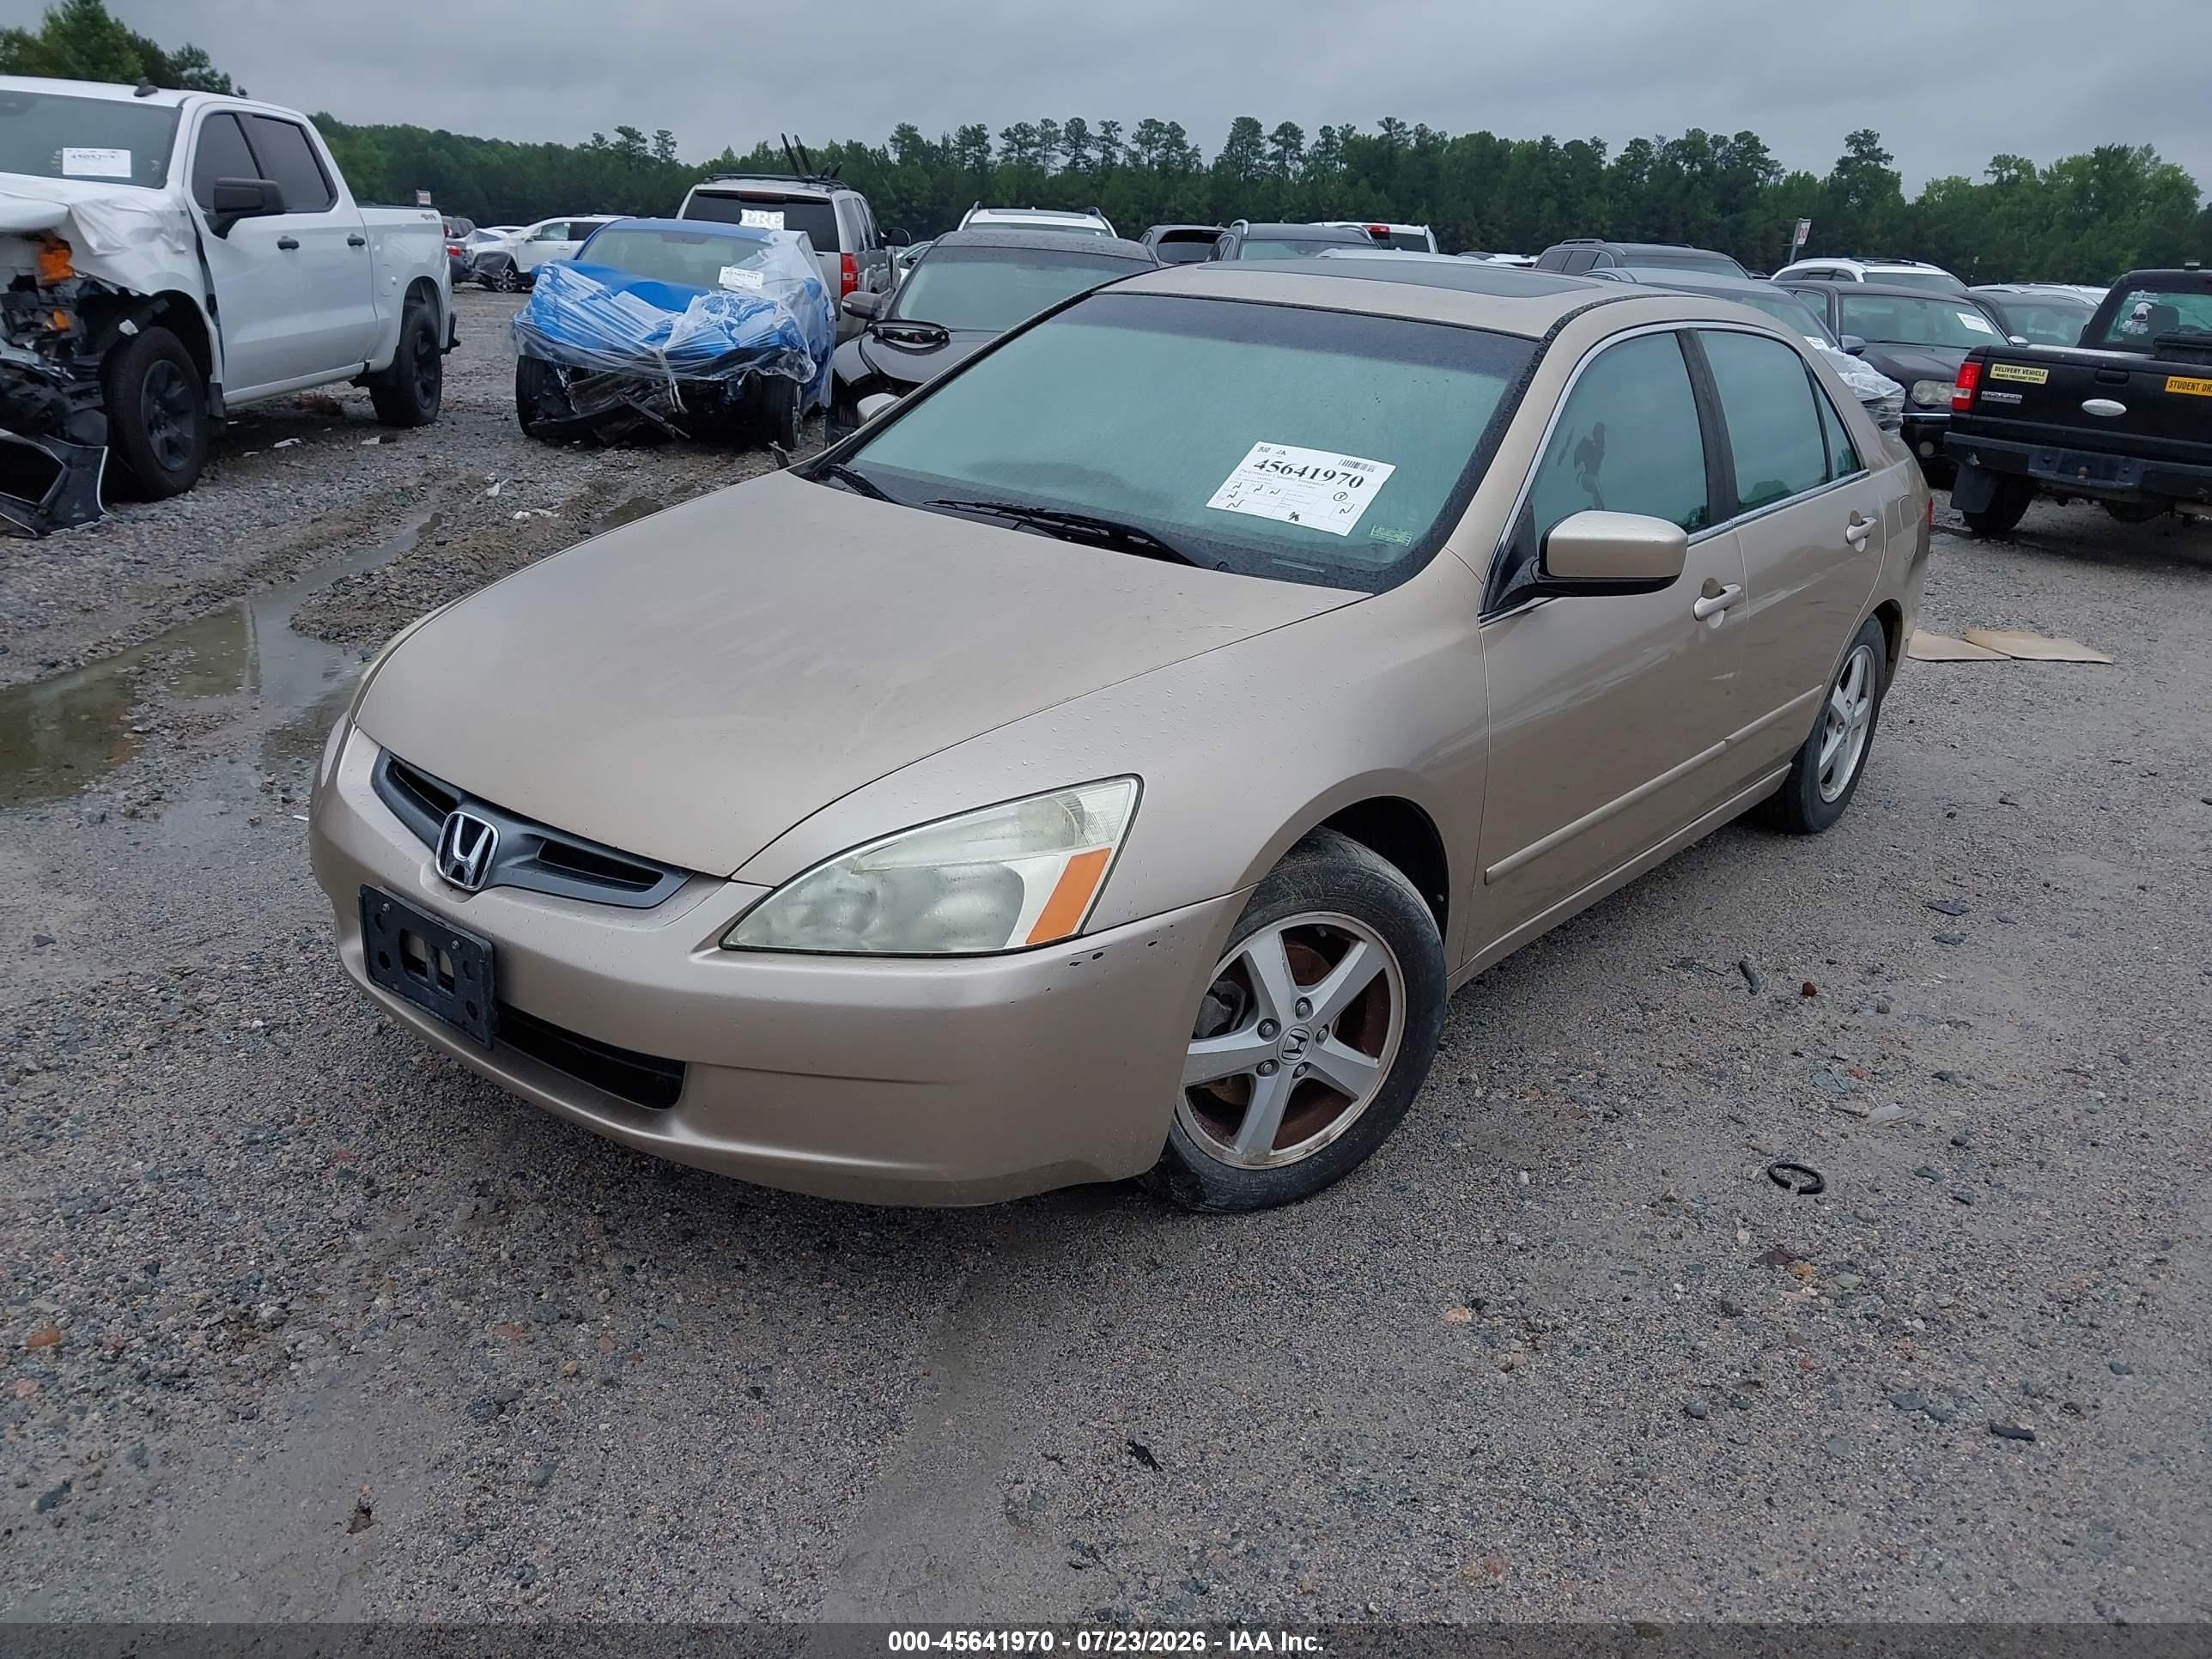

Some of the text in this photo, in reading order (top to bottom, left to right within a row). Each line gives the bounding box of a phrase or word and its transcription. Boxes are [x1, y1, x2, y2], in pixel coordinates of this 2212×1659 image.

[1994, 365, 2046, 378] DELIVERY VEHICLE
[2168, 380, 2201, 392] STUDENT
[1253, 459, 1364, 489] 45641970
